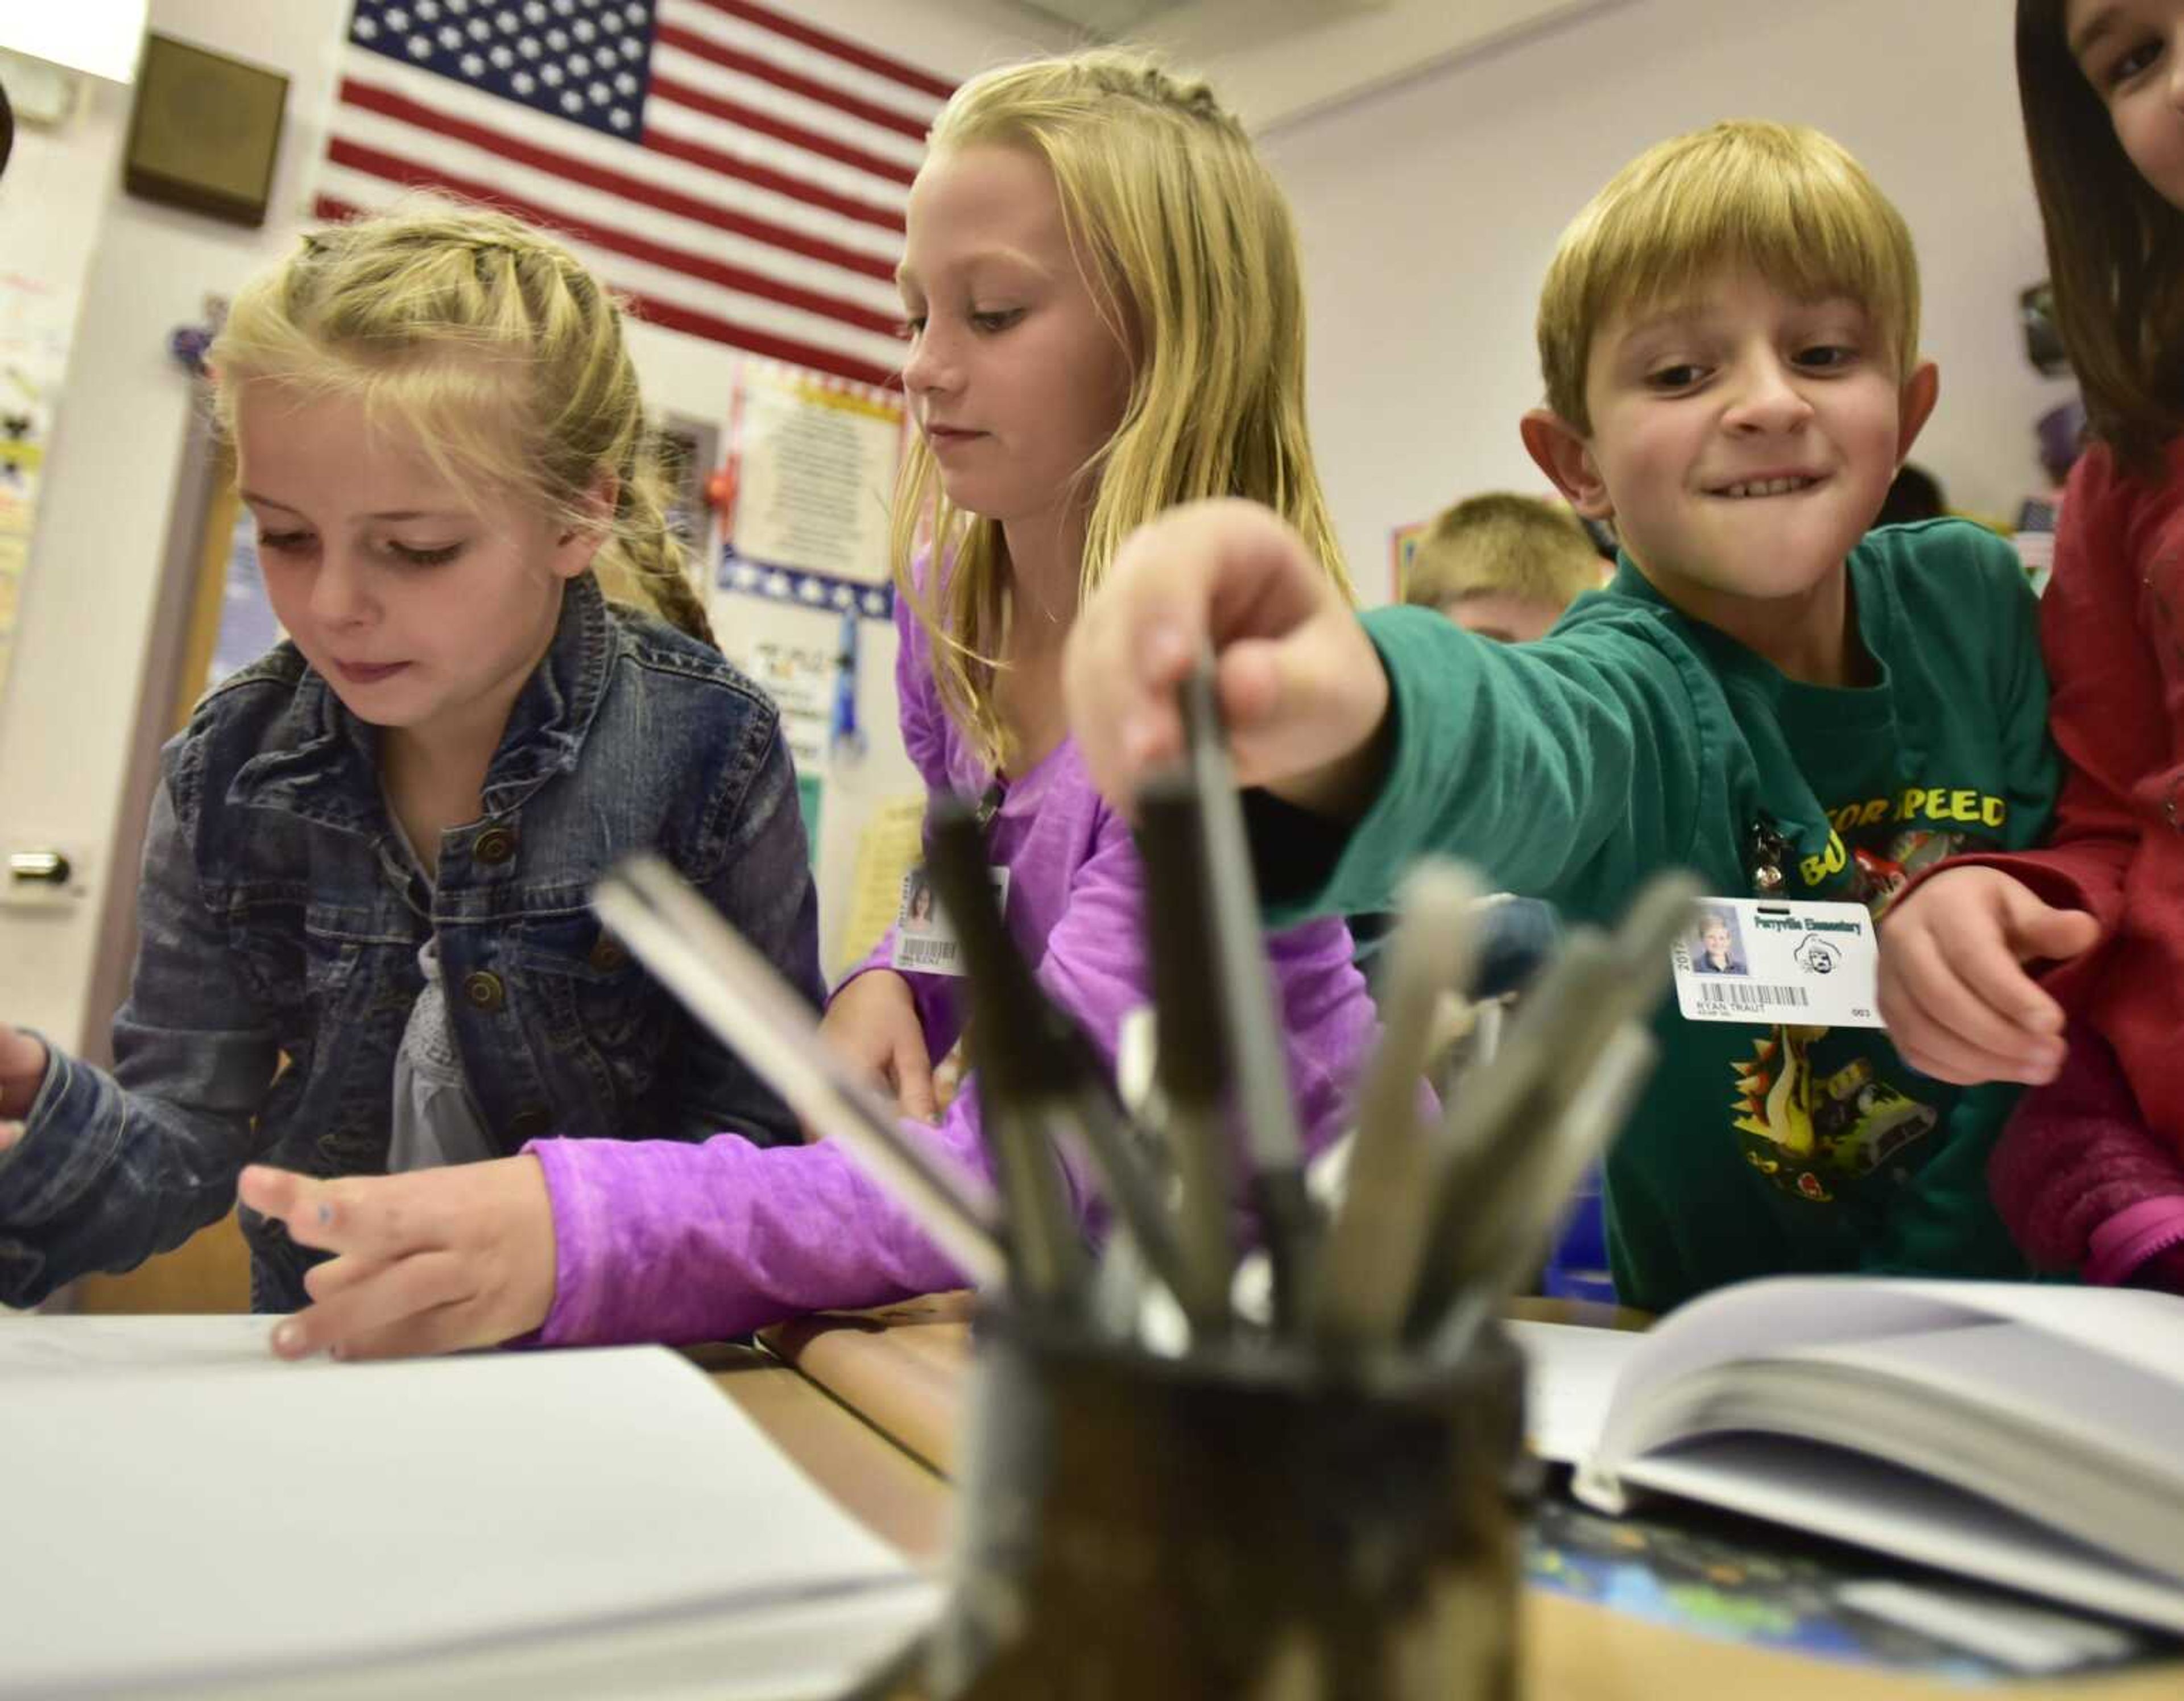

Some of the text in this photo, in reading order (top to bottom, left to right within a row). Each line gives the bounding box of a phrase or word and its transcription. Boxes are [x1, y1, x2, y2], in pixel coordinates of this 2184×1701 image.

[1895, 788, 2006, 827] PEED
[1754, 916, 1861, 936] Perryville Elementary
